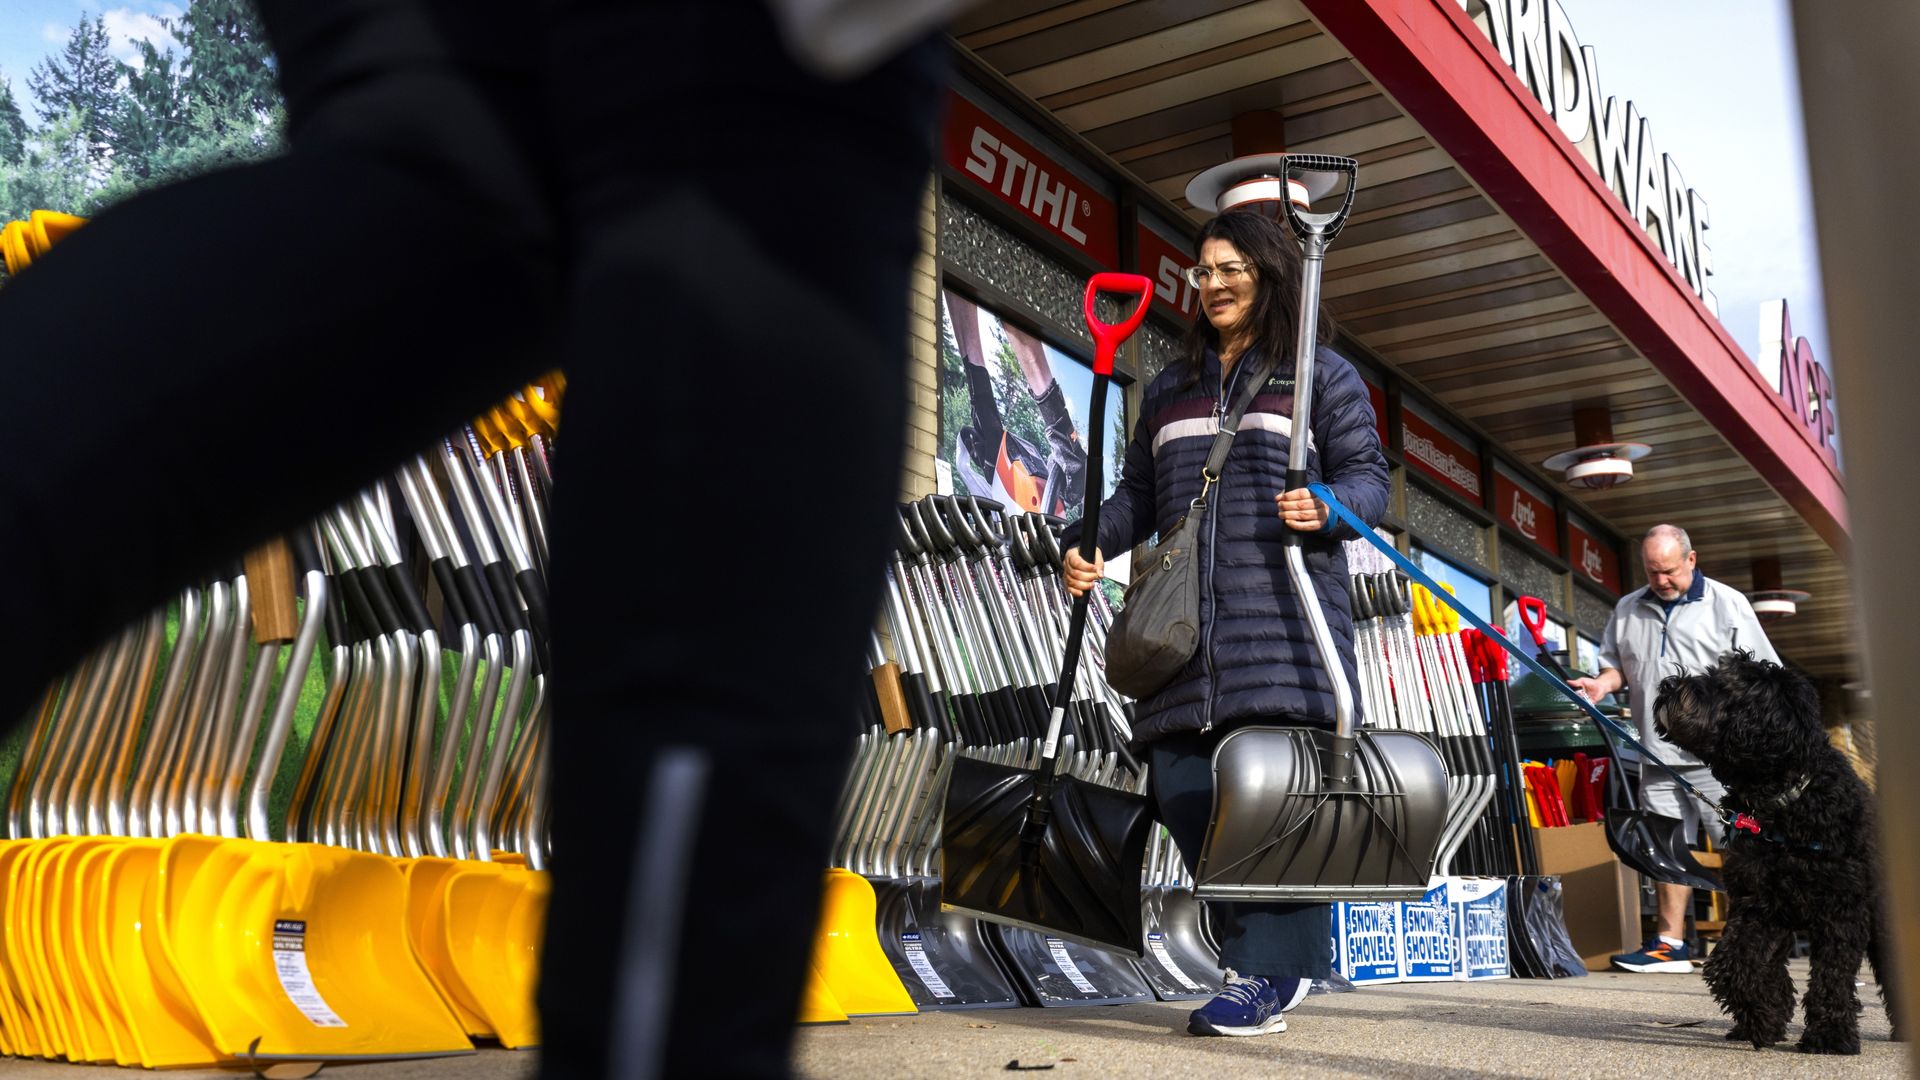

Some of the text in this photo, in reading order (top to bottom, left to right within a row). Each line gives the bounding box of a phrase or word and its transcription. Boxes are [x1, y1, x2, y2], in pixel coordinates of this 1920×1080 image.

[965, 126, 1088, 246] STIHL
[1351, 909, 1379, 933] SNOW
[1408, 909, 1435, 933] SNOW
[1468, 912, 1491, 936] SNOW
[1349, 936, 1396, 963] SHOVELS
[1406, 935, 1450, 961] SHOVELS
[1467, 939, 1505, 965] SHOVELS
